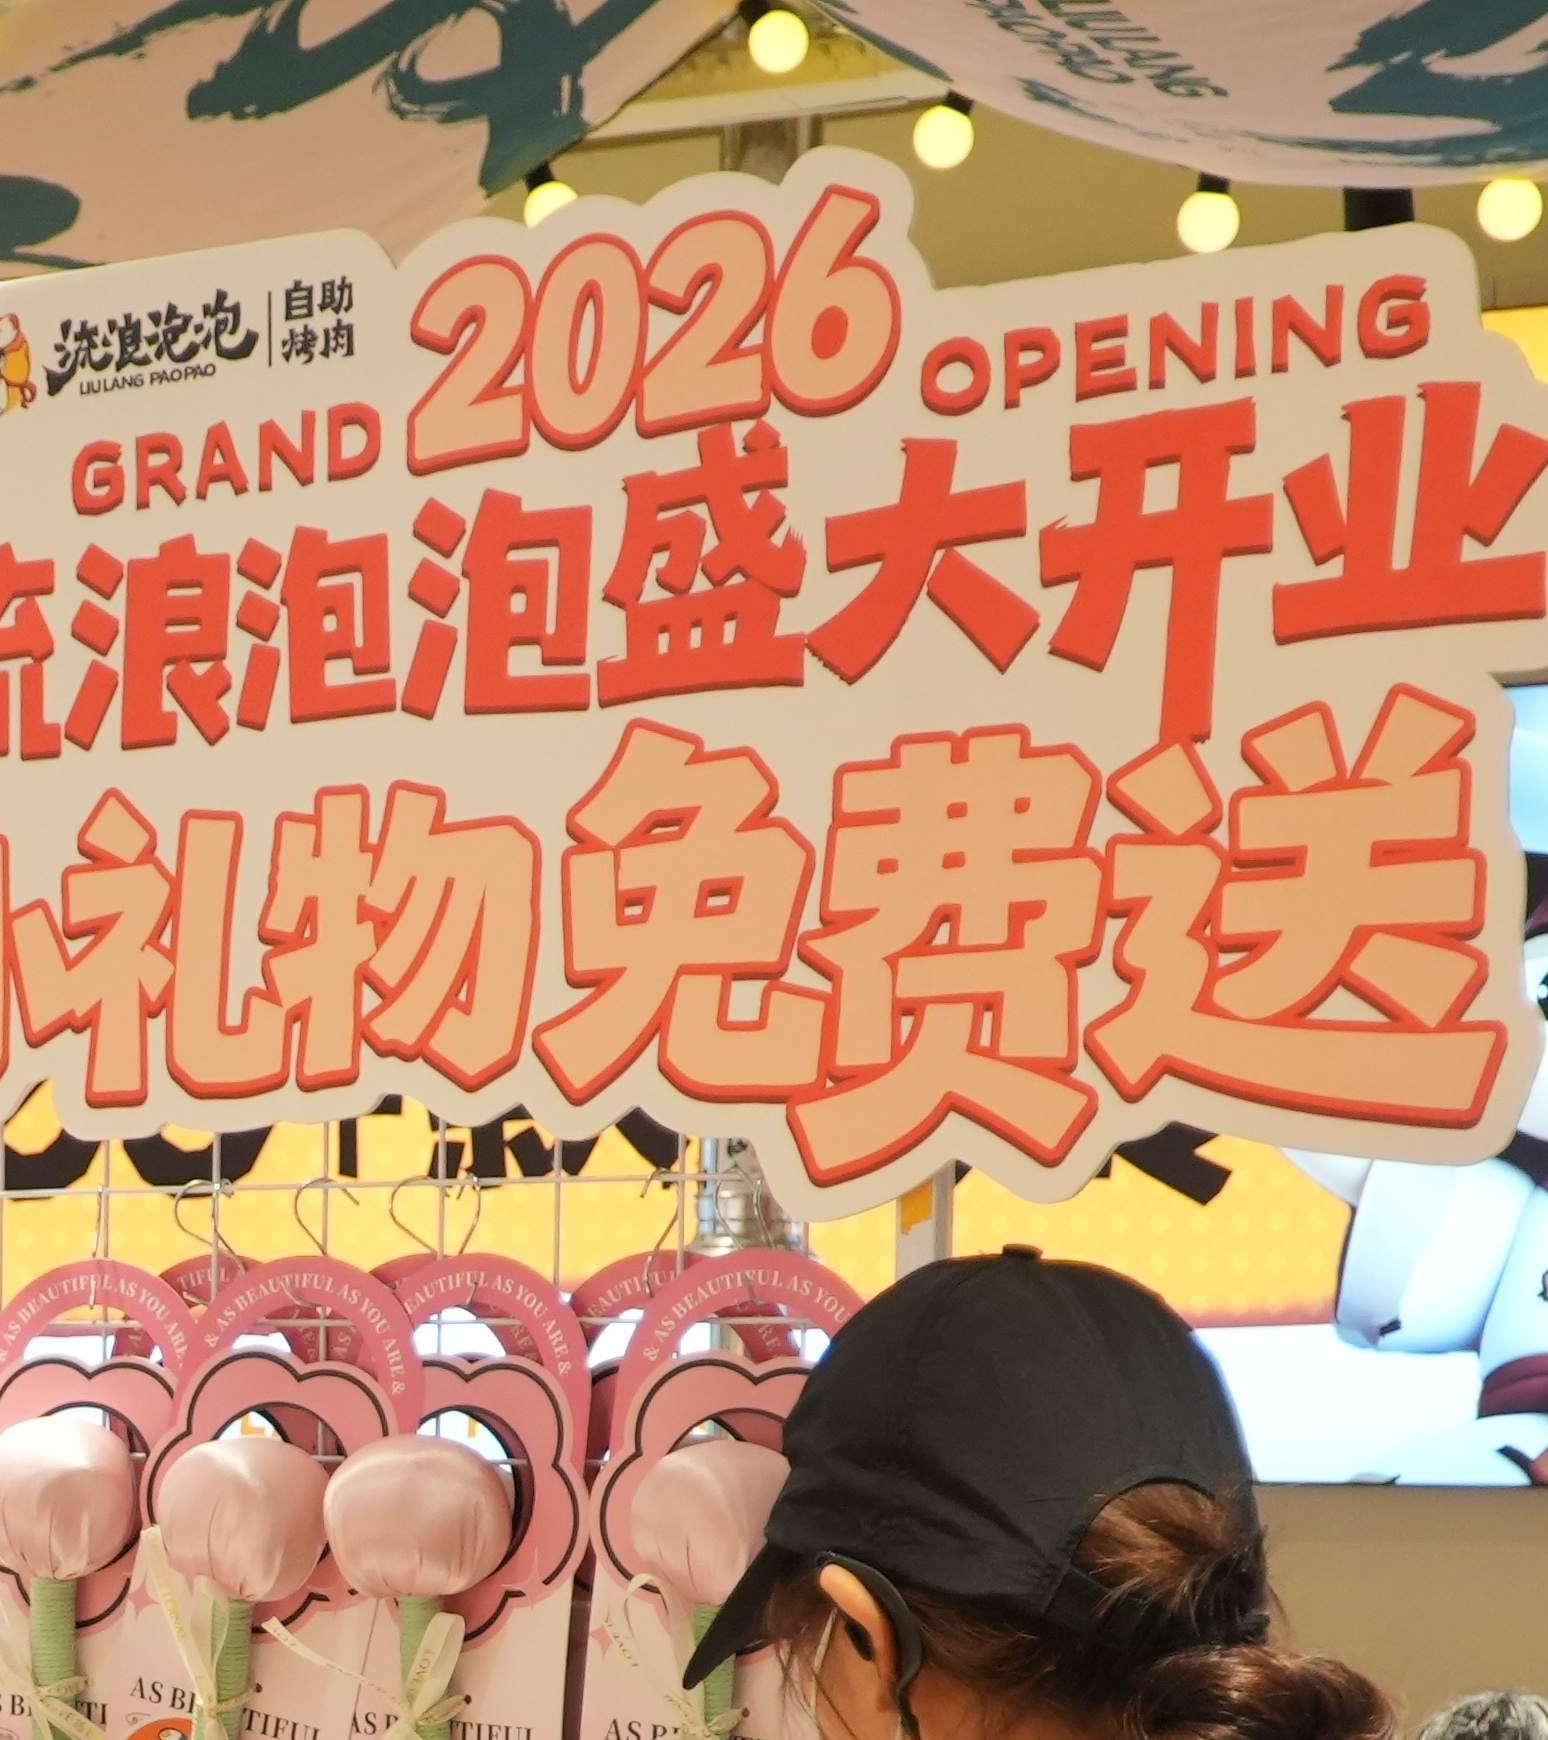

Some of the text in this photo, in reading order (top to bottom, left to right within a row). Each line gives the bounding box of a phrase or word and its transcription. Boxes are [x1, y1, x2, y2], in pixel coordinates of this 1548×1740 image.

[42, 288, 260, 397] 流浪泡泡
[280, 318, 355, 365] 烤肉
[283, 275, 355, 322] 自助
[406, 183, 902, 476] 2026
[919, 273, 1432, 417] OPENING
[70, 400, 382, 516] GRAND
[3, 1323, 22, 1347] AS
[17, 1273, 113, 1324] BEAUTIFUL
[114, 1278, 138, 1299] AS
[138, 1289, 172, 1322] YOU
[216, 1307, 237, 1332] AS
[234, 1272, 335, 1312] BEAUTIFUL
[337, 1283, 361, 1305] AS
[360, 1298, 390, 1335] YOU
[383, 1336, 406, 1380] ARE
[404, 1270, 573, 1376] EAUTIFUL AS YOU ARE &
[653, 1321, 677, 1345] AS
[673, 1268, 784, 1320] BEAUTIFUL
[786, 1274, 812, 1297] AS
[813, 1287, 853, 1324] YOU
[130, 1676, 165, 1705] AS
